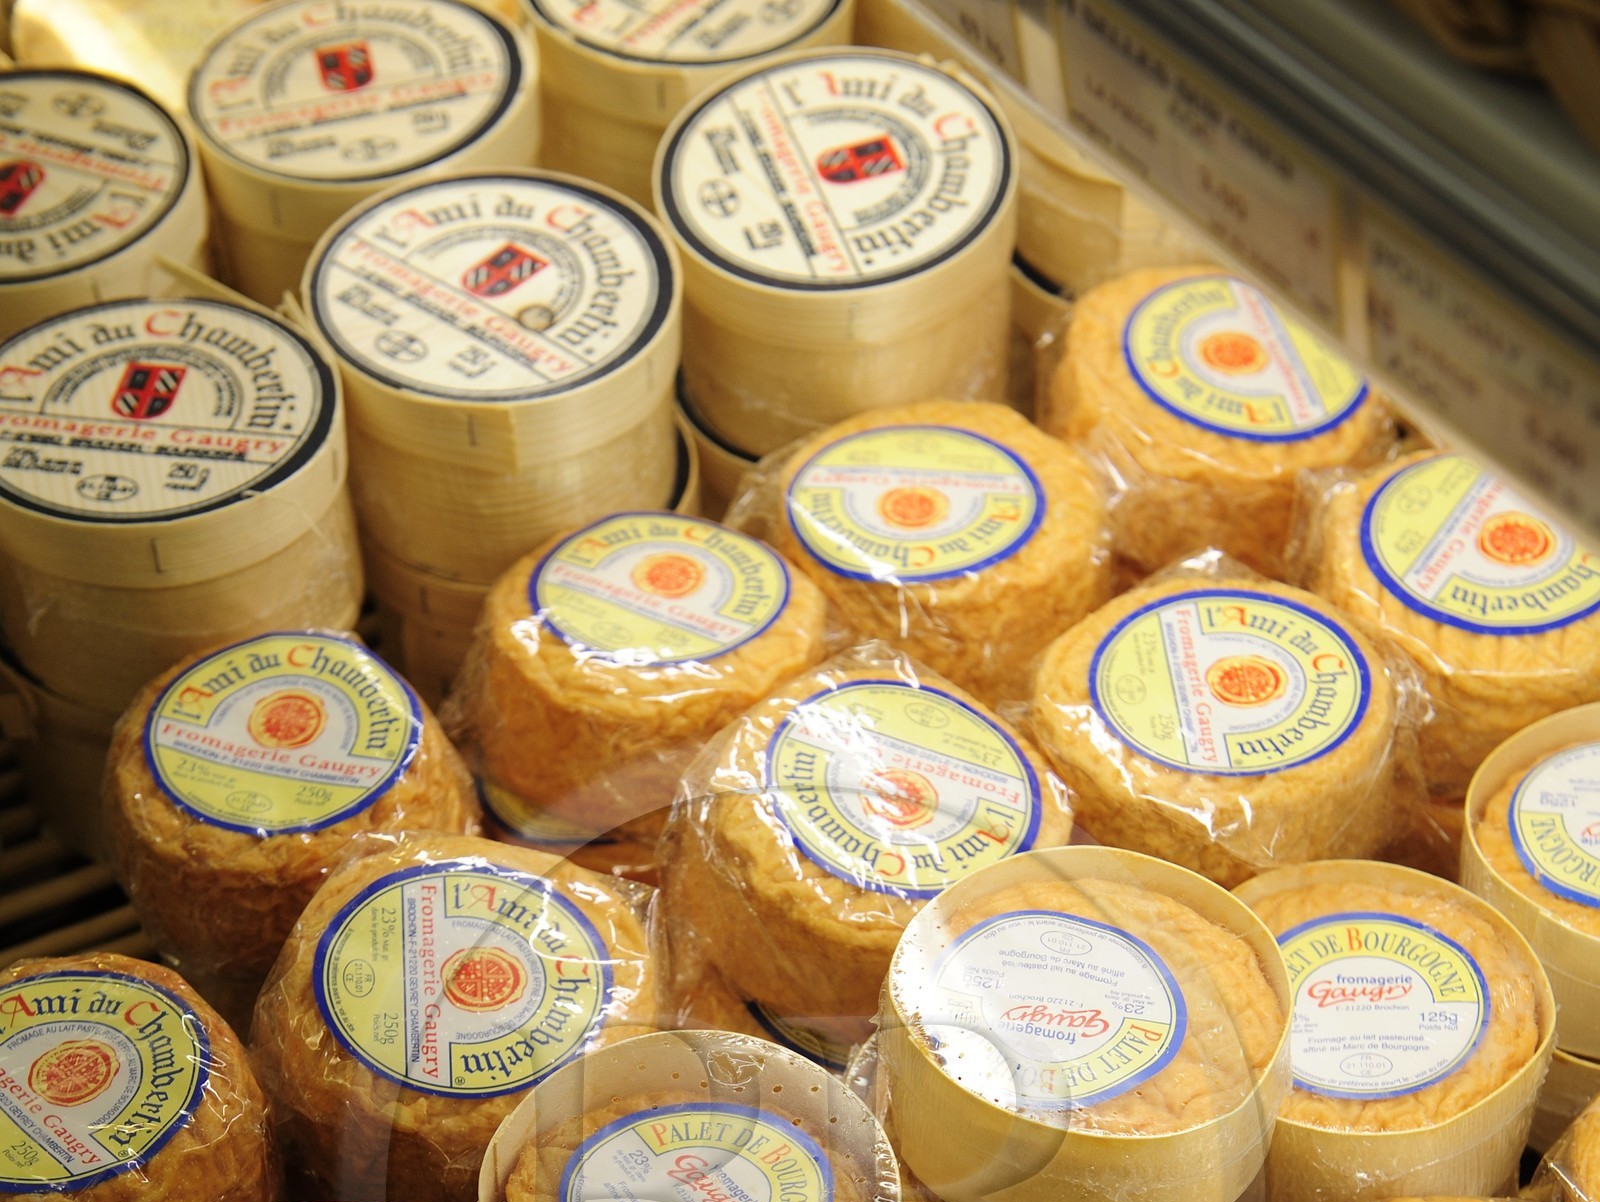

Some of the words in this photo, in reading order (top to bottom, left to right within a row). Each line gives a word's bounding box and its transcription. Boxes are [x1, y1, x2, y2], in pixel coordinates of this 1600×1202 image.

[854, 111, 980, 258] Chambertin
[494, 194, 536, 220] du
[546, 205, 636, 351] Chambertin
[89, 321, 137, 346] du
[145, 309, 297, 432] Chambertin
[170, 428, 286, 454] Gaugry
[1452, 551, 1600, 616] hambertin
[1289, 630, 1321, 656] du
[171, 660, 246, 720] l'Ami
[247, 652, 281, 675] du
[286, 643, 400, 752] Chambertin
[1175, 609, 1207, 698] Fromagerie
[1195, 702, 1218, 764] Gaugry
[1237, 652, 1348, 761] Chambertin
[162, 723, 291, 765] Fromagerie
[299, 754, 382, 781] Gaugry
[295, 785, 335, 803] 250g
[889, 753, 1022, 804] Fromagerie
[785, 750, 907, 877] Chambertin
[381, 907, 397, 938] 23%
[420, 884, 440, 998] Fromagerie
[1308, 933, 1344, 960] DE
[1344, 926, 1467, 998] BOURGOGNE
[1336, 973, 1414, 987] fromagerie
[460, 954, 591, 1081] Chambertin
[1307, 980, 1413, 1010] Gaugry
[1419, 1012, 1460, 1026] 125g
[7, 1027, 43, 1051] FROMAGE
[58, 1024, 75, 1033] LAIT
[381, 1012, 399, 1045] 250g
[409, 1008, 421, 1063] CHAMBERTIN
[421, 1004, 441, 1080] Gaugry
[1000, 1005, 1111, 1039] Gaugry
[1308, 1034, 1347, 1045] Fromage
[1378, 1033, 1425, 1043] pasteurisé
[87, 990, 124, 1016] du
[109, 1001, 185, 1147] Chambertin
[1104, 1022, 1164, 1075] PALET
[1302, 1044, 1329, 1055] affiné
[1343, 1042, 1366, 1051] Marc
[1381, 1043, 1431, 1053] Bourgogne
[1061, 1061, 1099, 1088] DE
[9, 1105, 37, 1130] GEVREY
[32, 1127, 76, 1164] CHAMBERTIN
[11, 1140, 41, 1167] 250g
[43, 1114, 102, 1165] Gaugry
[650, 1121, 734, 1149] PALET
[736, 1127, 771, 1157] DE
[628, 1149, 653, 1175] 23%
